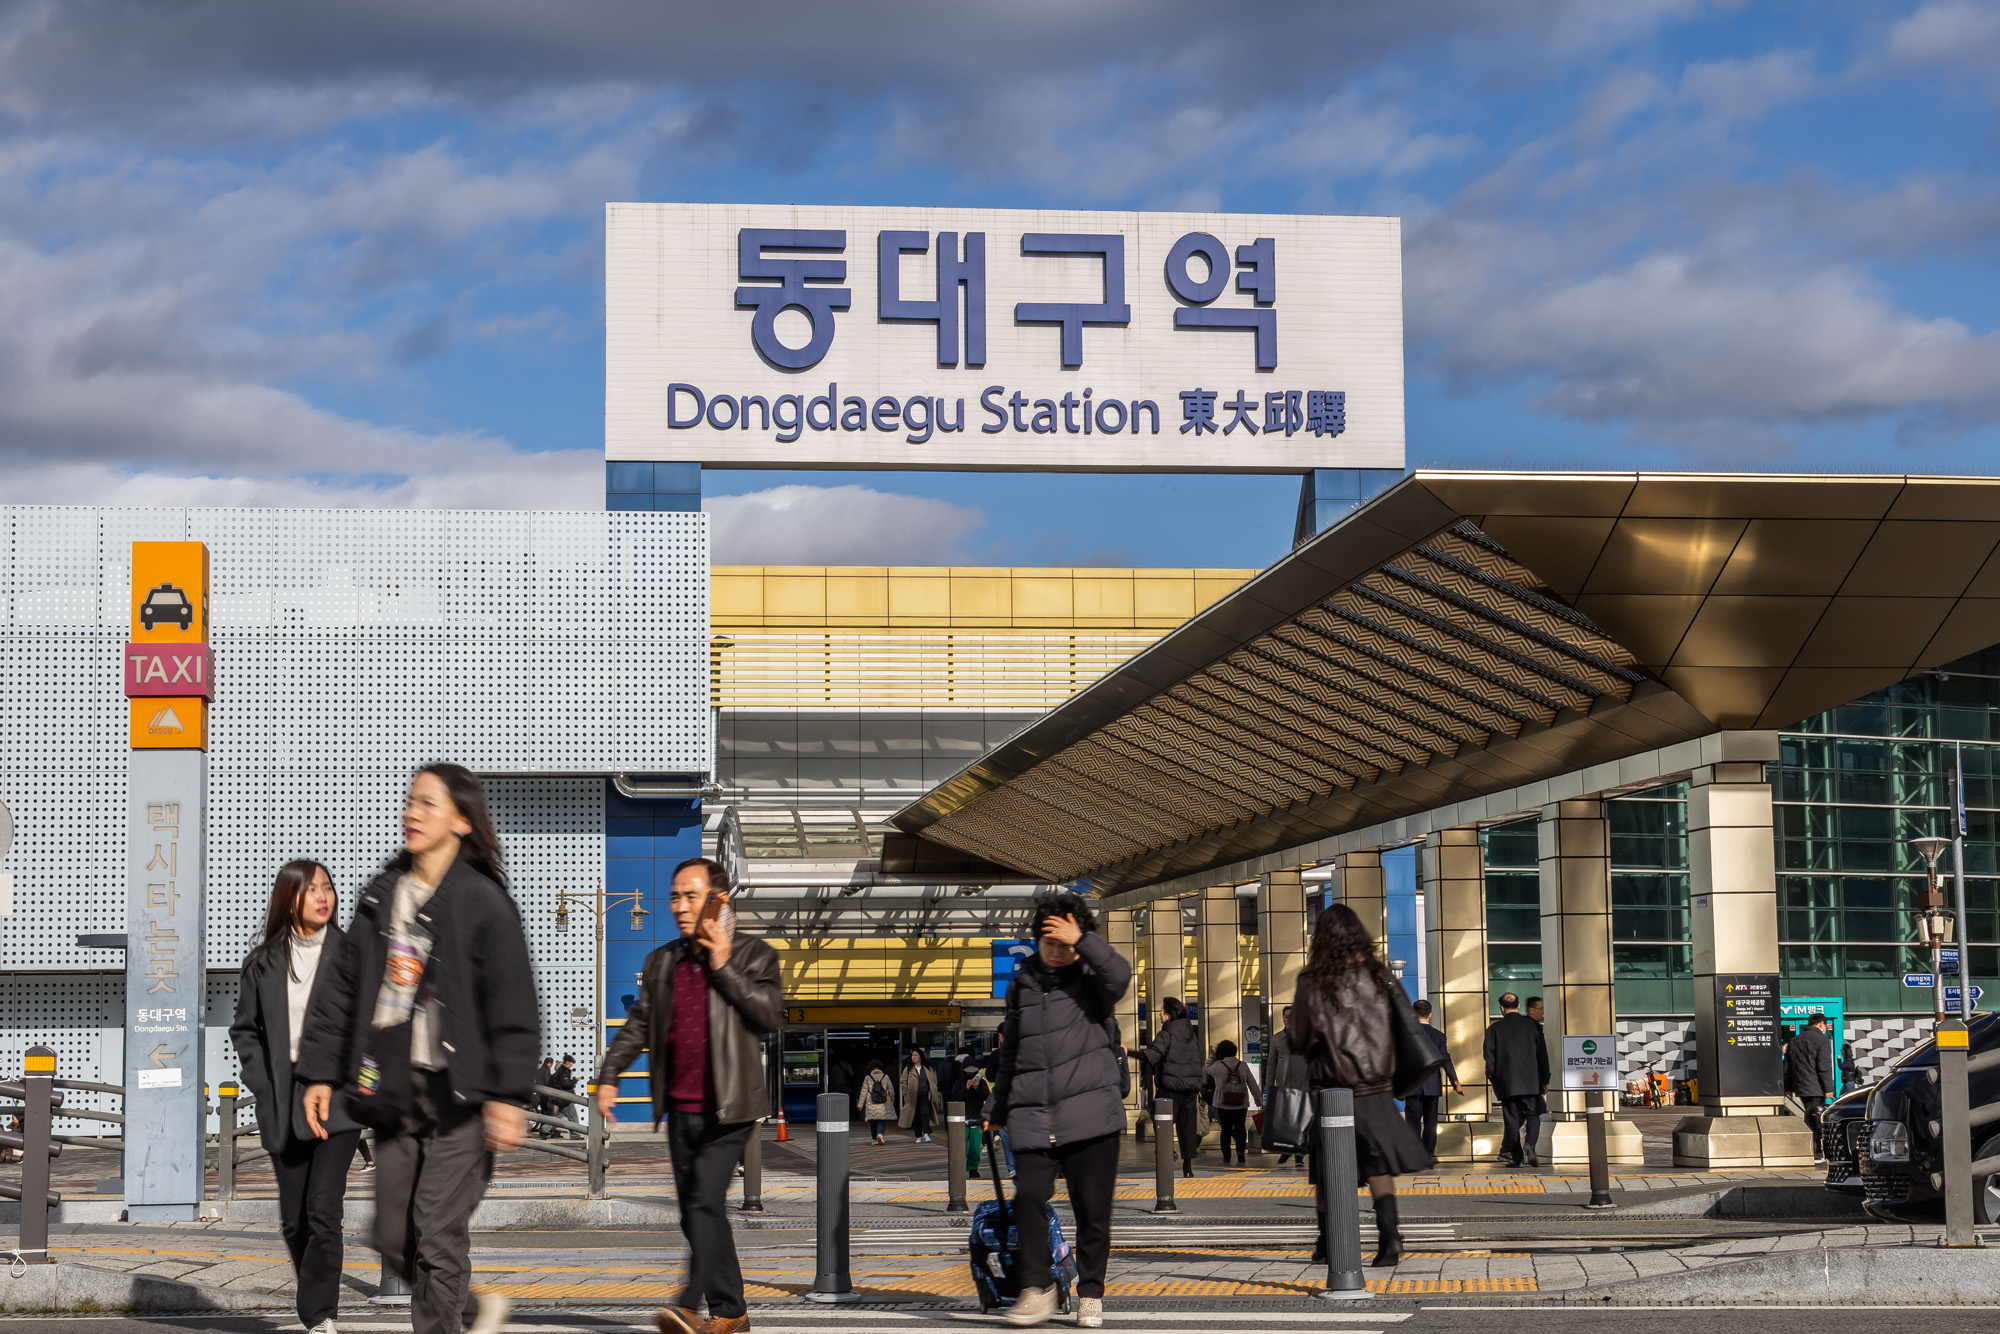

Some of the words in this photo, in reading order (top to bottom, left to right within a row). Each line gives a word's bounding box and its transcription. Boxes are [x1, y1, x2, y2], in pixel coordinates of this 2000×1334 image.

[735, 228, 1277, 372] 동대구역
[667, 381, 965, 443] Dongdaegu
[980, 386, 1160, 436] Station
[1179, 388, 1347, 438] 東大邱驛
[128, 655, 202, 684] TAXI
[148, 727, 173, 735] DAEGU
[136, 1007, 187, 1022] 동대구역
[798, 1009, 805, 1021] 3
[134, 1025, 175, 1033] Dongdaegu
[175, 1024, 190, 1032] Stn.
[1568, 1057, 1592, 1065] 흡연구역
[1594, 1057, 1612, 1065] 가는길
